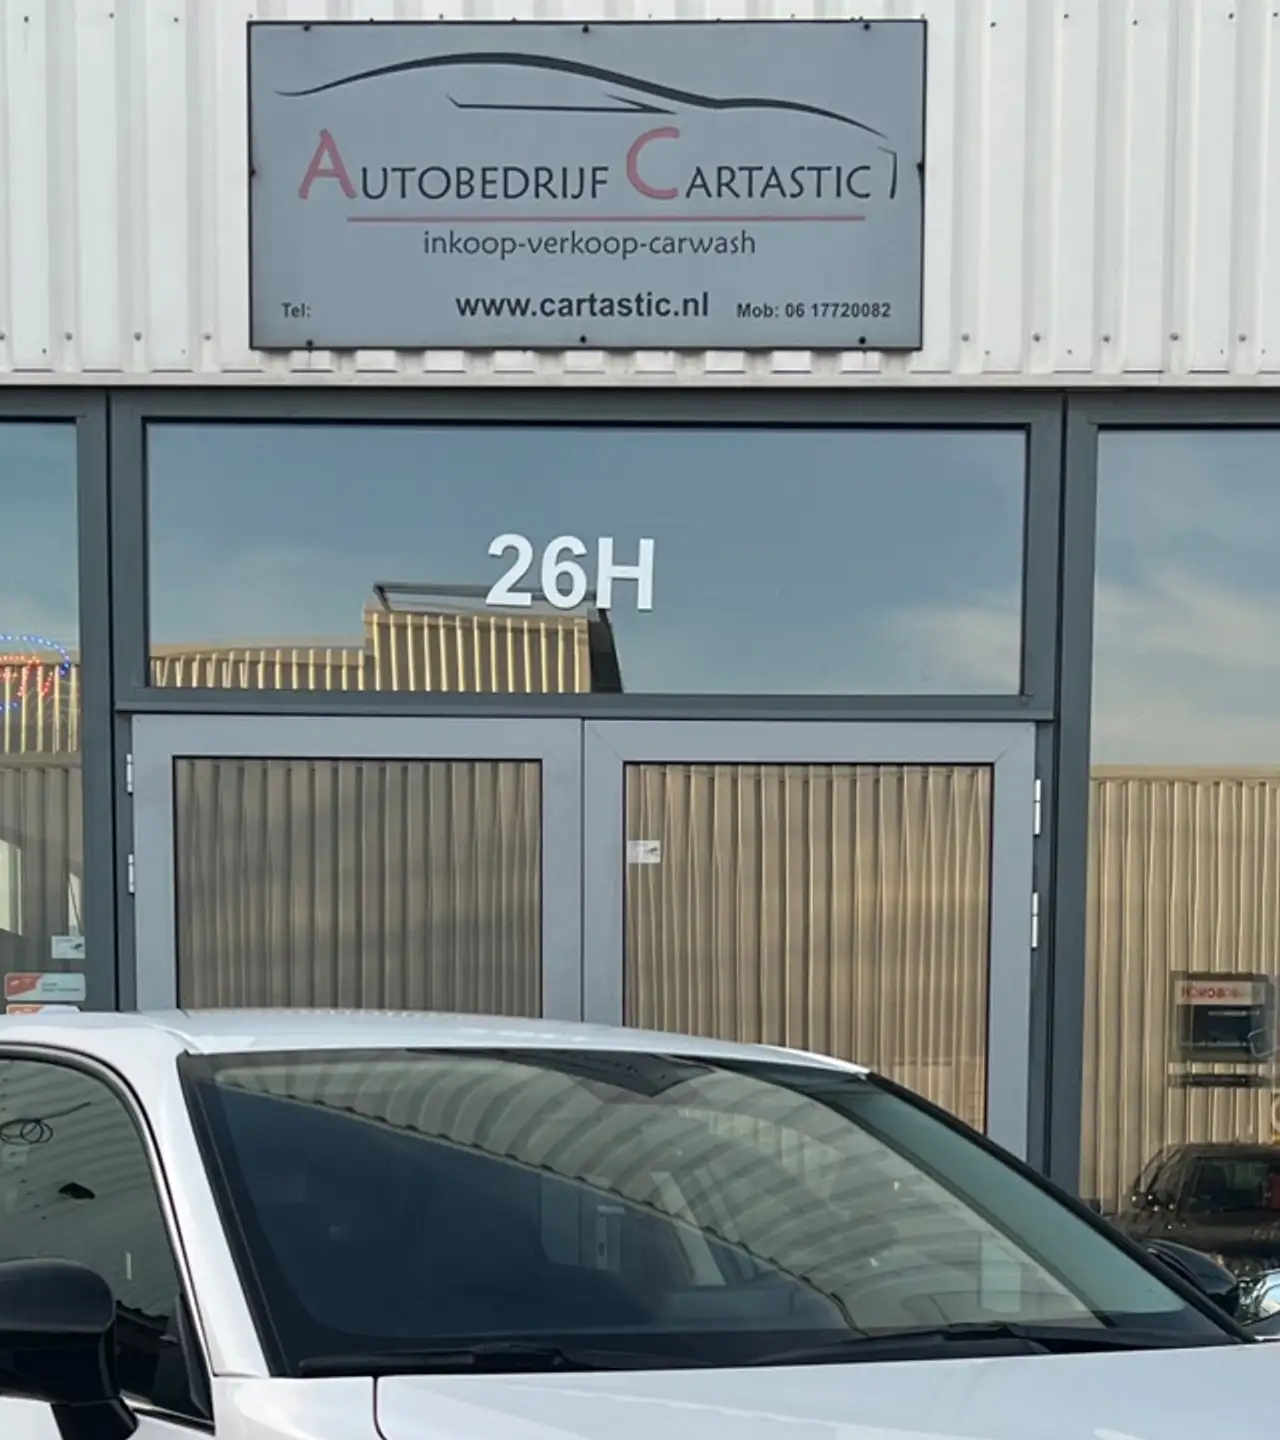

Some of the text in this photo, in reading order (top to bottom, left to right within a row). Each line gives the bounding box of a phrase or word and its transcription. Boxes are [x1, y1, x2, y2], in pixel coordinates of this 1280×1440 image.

[298, 126, 872, 200] AUTOBEDRIJF CARTASTIC
[423, 230, 756, 260] inkoop-verkoop-carwash
[281, 302, 312, 319] Tel:
[455, 292, 709, 318] www.cartastic.nl
[736, 303, 892, 319] Mob: 06 17720082
[486, 533, 655, 611] 26H
